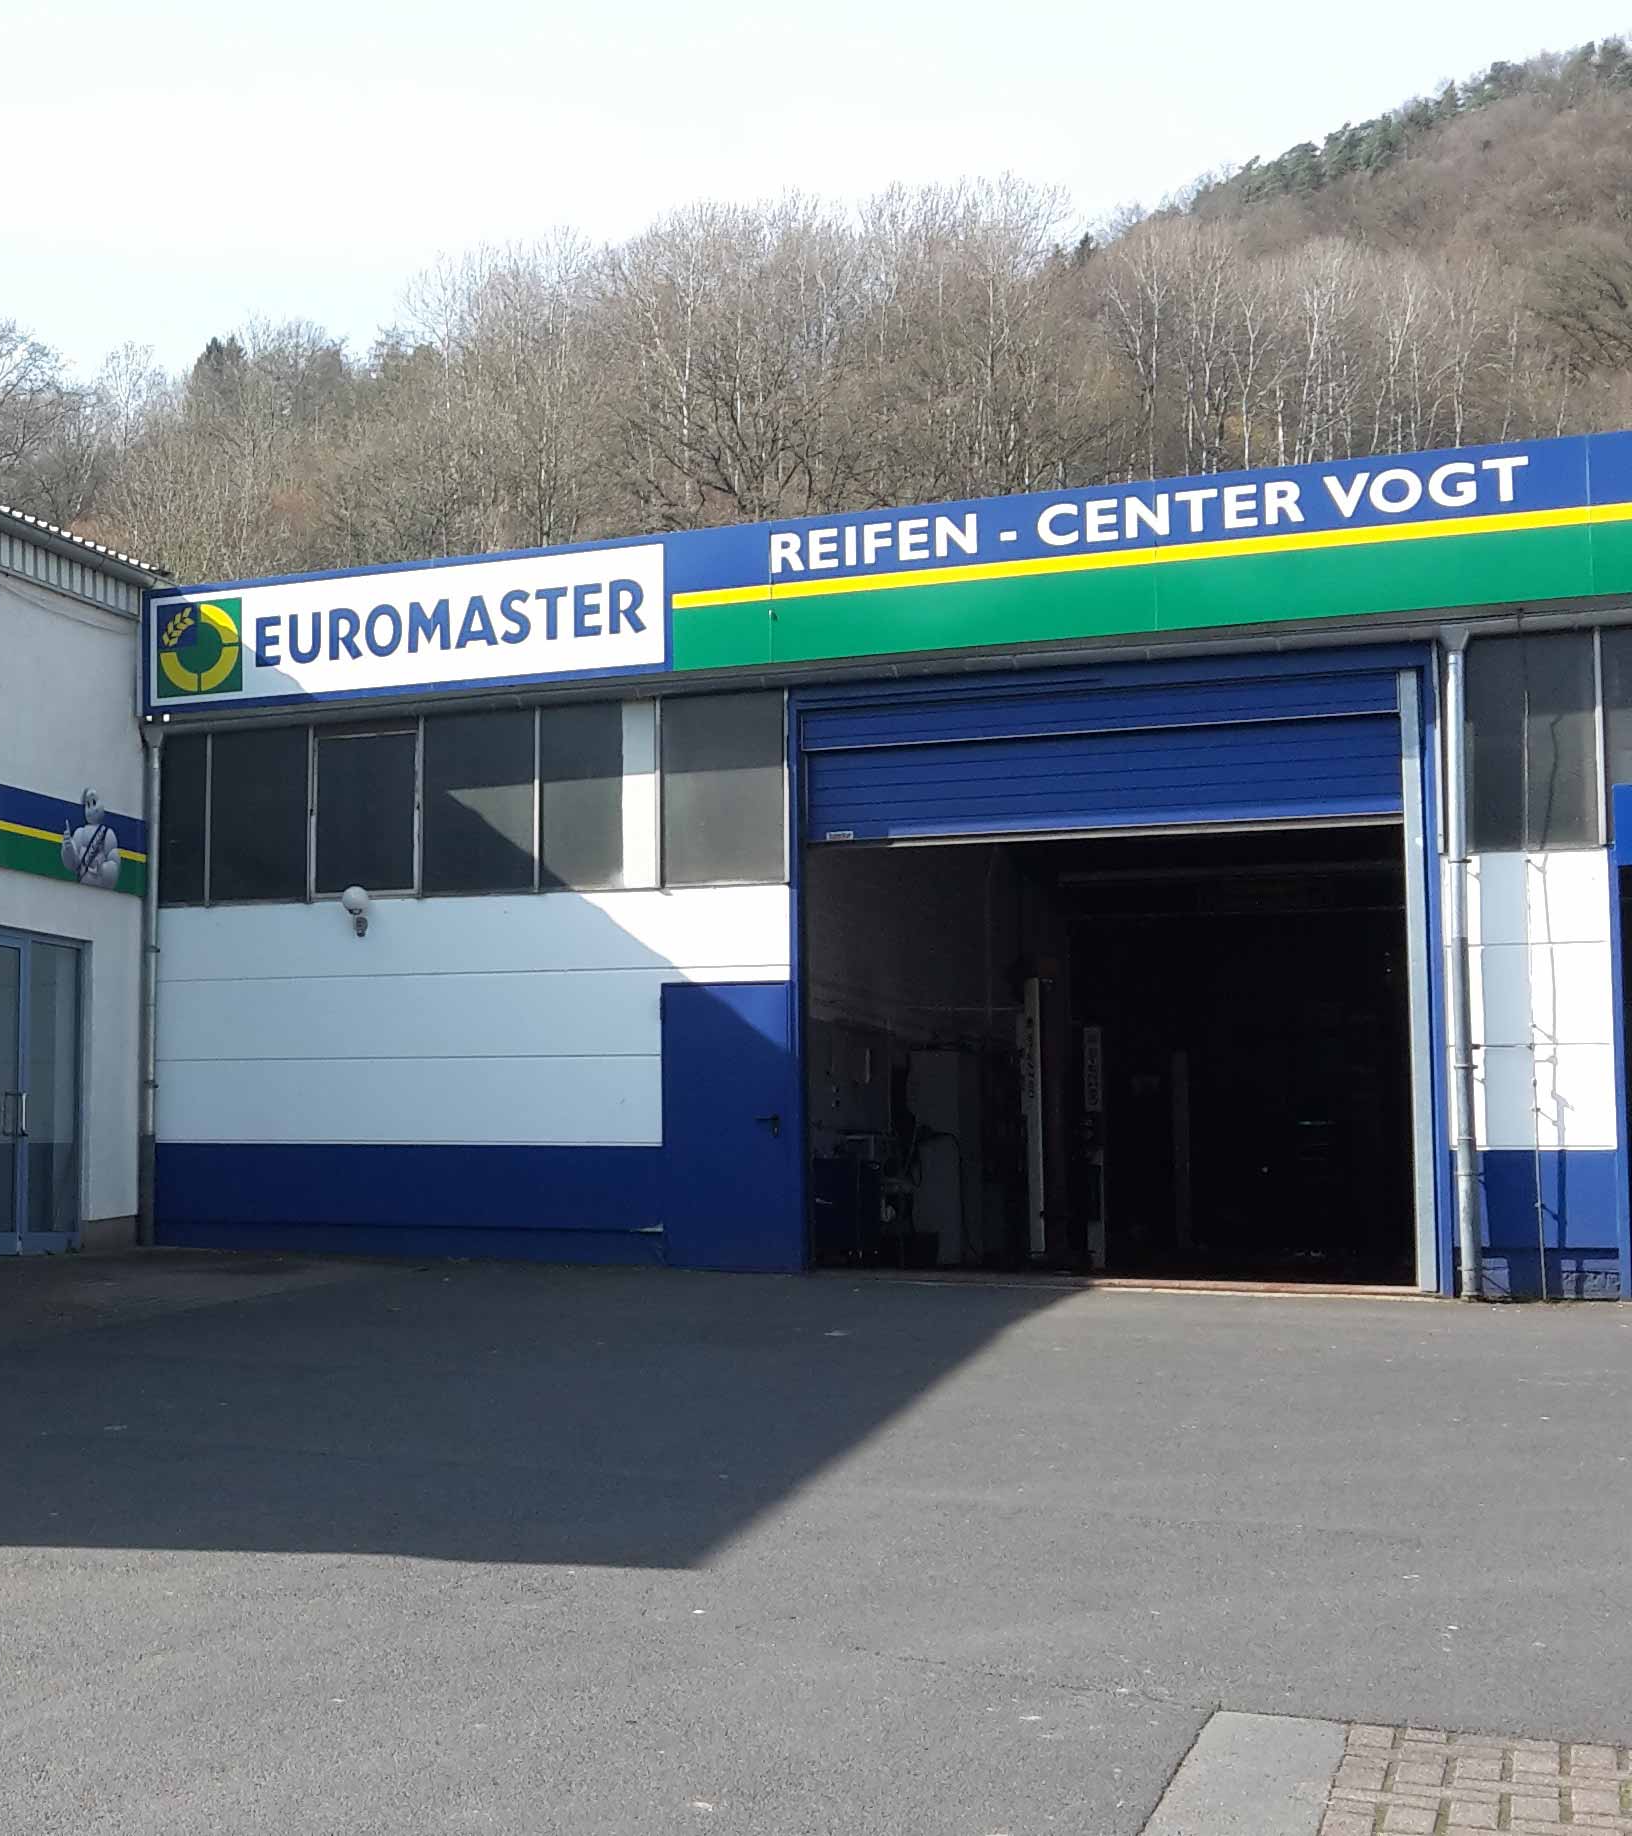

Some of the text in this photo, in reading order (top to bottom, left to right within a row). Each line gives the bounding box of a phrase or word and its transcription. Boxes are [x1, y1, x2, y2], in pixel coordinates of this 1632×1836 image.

[771, 512, 978, 575] REIFEN
[1037, 479, 1305, 547] CENTER
[1322, 455, 1529, 519] VOGT
[255, 578, 646, 668] EUROMASTER
